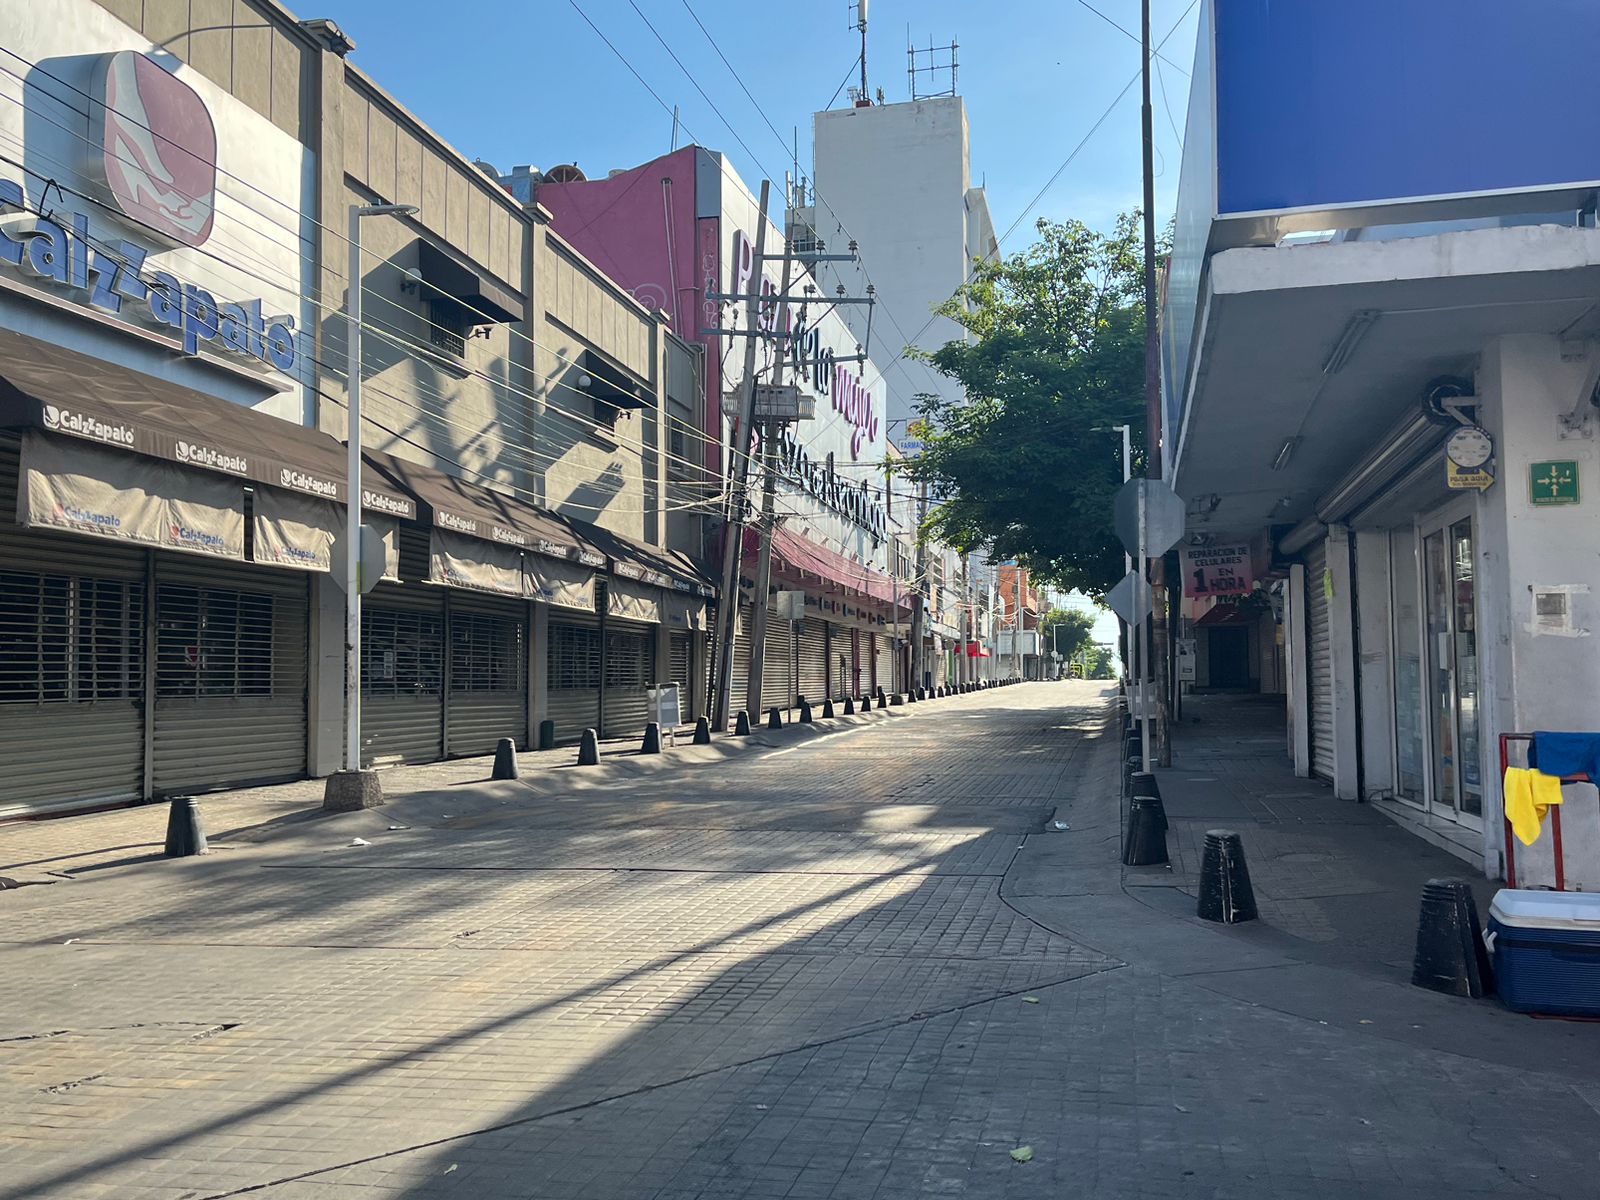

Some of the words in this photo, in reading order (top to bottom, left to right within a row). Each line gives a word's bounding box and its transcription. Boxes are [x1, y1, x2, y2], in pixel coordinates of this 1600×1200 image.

[734, 228, 794, 356] Paza
[60, 410, 134, 445] Calzzapato
[189, 443, 247, 473] Calzzapato
[291, 471, 336, 495] Calzzapato
[1194, 556, 1242, 567] CELULARES
[1237, 546, 1247, 556] DE
[1193, 568, 1208, 593] 1
[1210, 576, 1247, 592] HORA
[1217, 567, 1234, 577] EN
